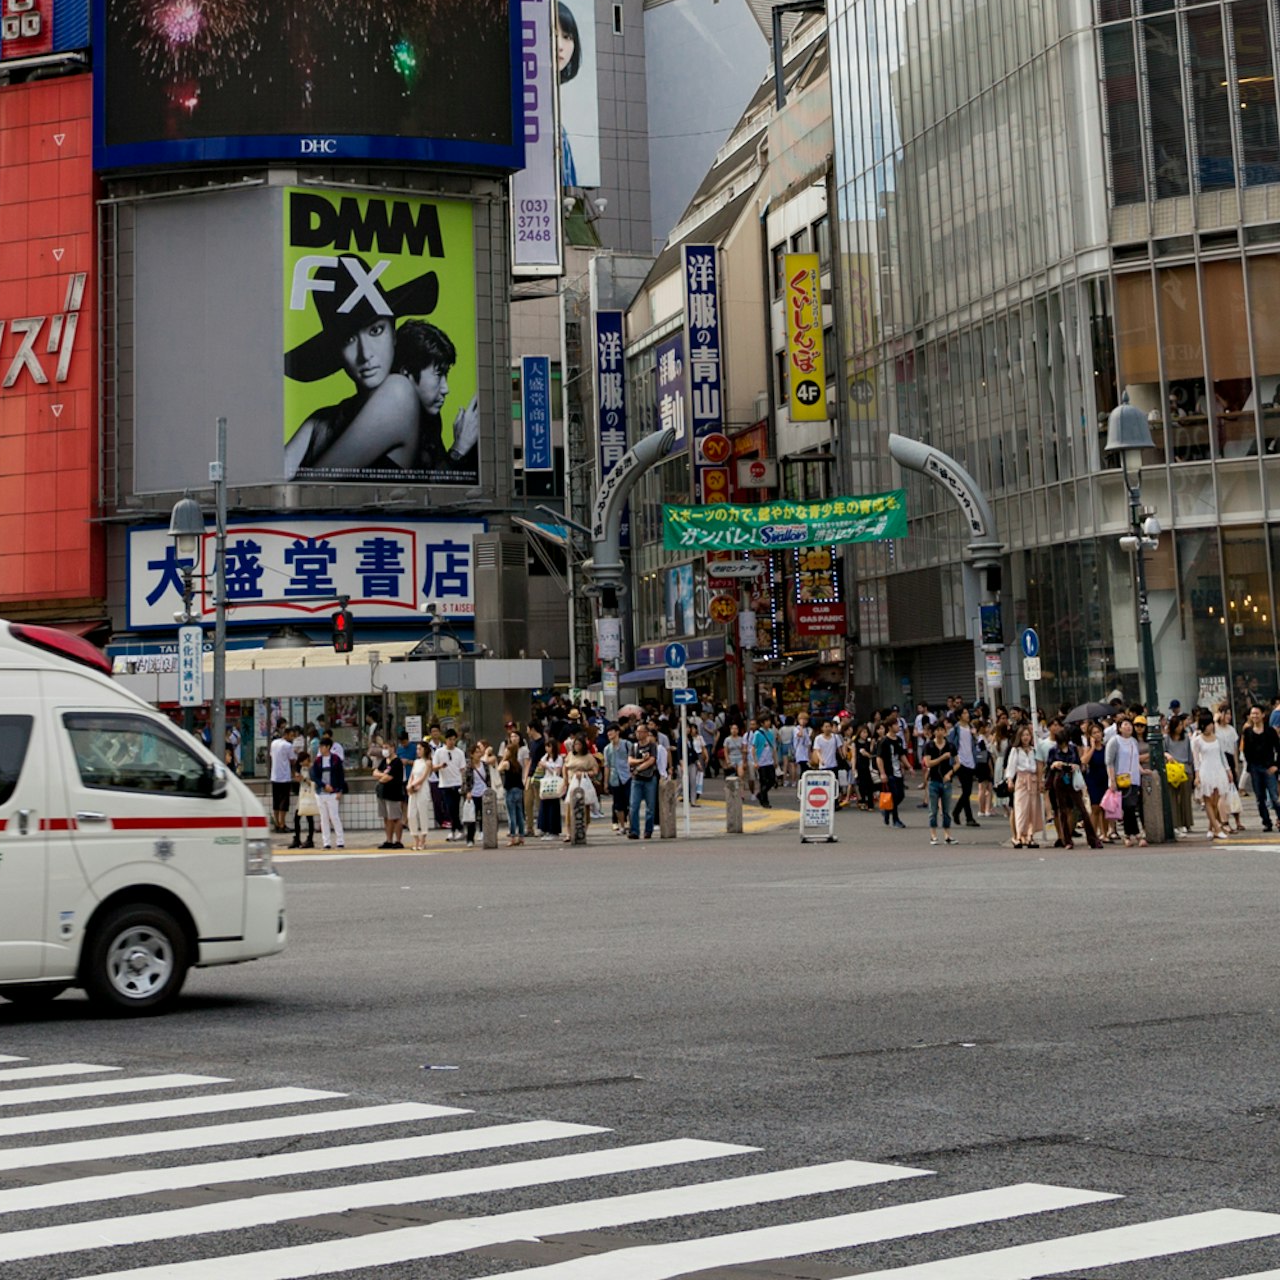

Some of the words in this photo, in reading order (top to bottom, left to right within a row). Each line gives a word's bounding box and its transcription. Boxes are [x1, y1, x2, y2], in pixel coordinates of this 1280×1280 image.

[523, 33, 540, 144] neon
[300, 139, 336, 153] DHC
[289, 192, 445, 258] DMM
[519, 215, 551, 228] 3719
[520, 199, 548, 214] (03)
[519, 229, 551, 242] 2468
[290, 256, 394, 315] FX
[687, 254, 719, 421] 洋服の青山
[790, 270, 820, 373] くいしんぼ
[797, 384, 818, 400] 4F
[528, 362, 547, 465] 大盛堂商事ビル
[661, 390, 684, 441] 青山
[760, 526, 808, 545] Swallows
[814, 519, 889, 542] 渋谷センター街
[145, 537, 470, 606] 大盛堂書店
[799, 615, 816, 623] GAS
